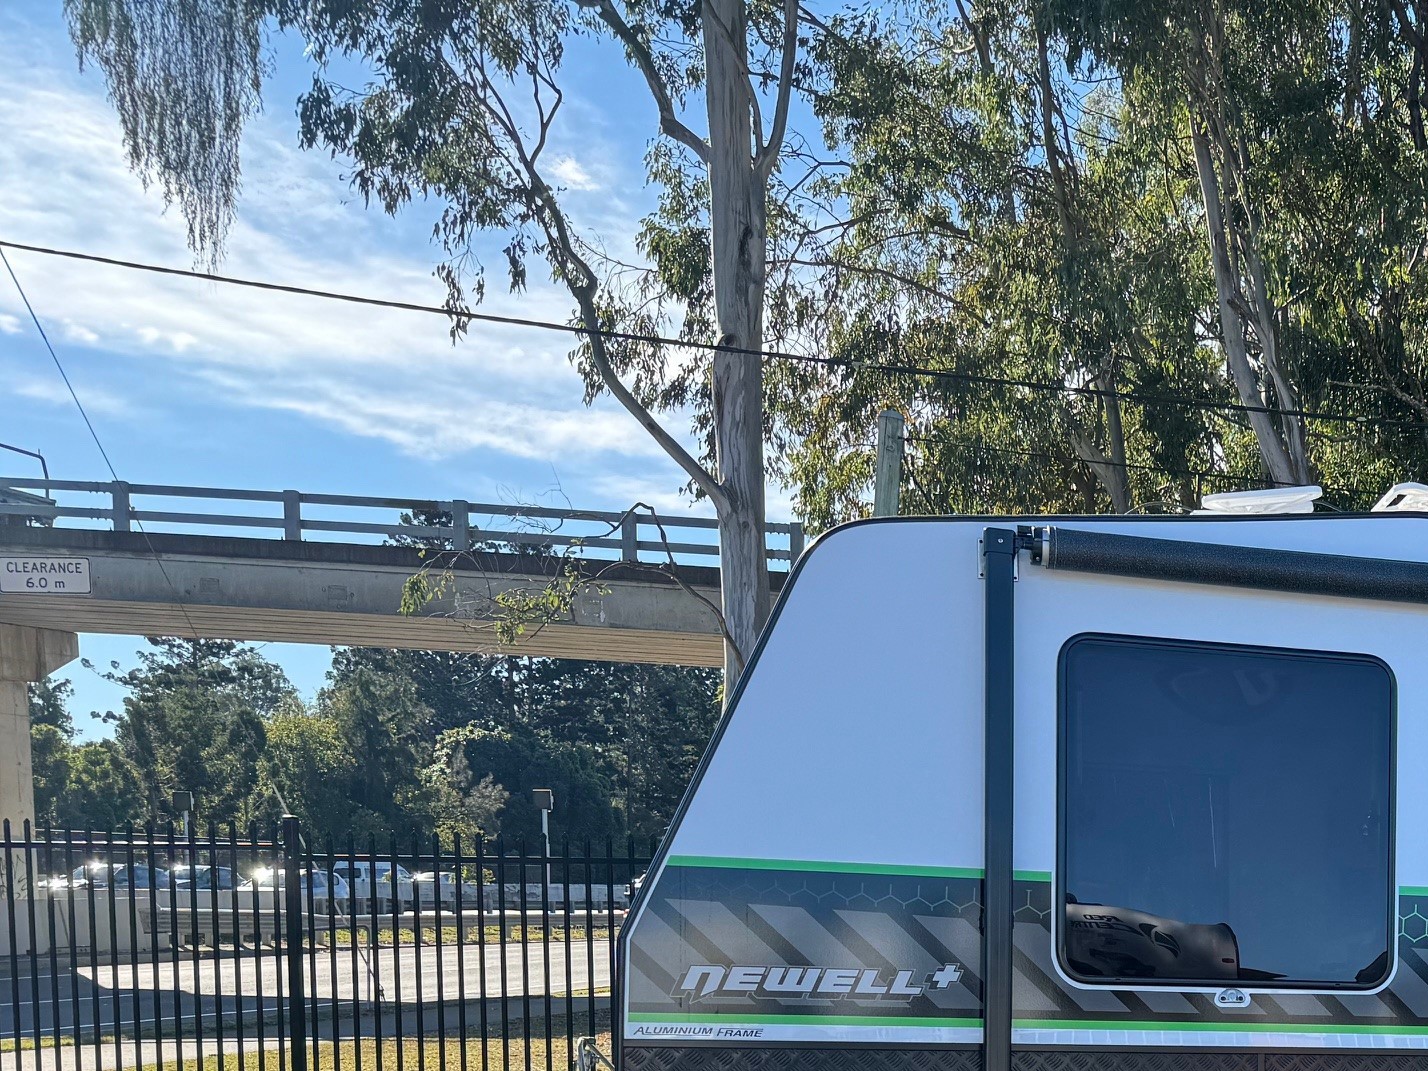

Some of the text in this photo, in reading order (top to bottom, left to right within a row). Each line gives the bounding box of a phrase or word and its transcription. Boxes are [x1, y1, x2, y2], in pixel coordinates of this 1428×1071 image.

[6, 561, 82, 573] CLEARANCE
[26, 577, 65, 588] 6.0 m
[633, 1026, 764, 1038] ALUMINIUM FRAME
